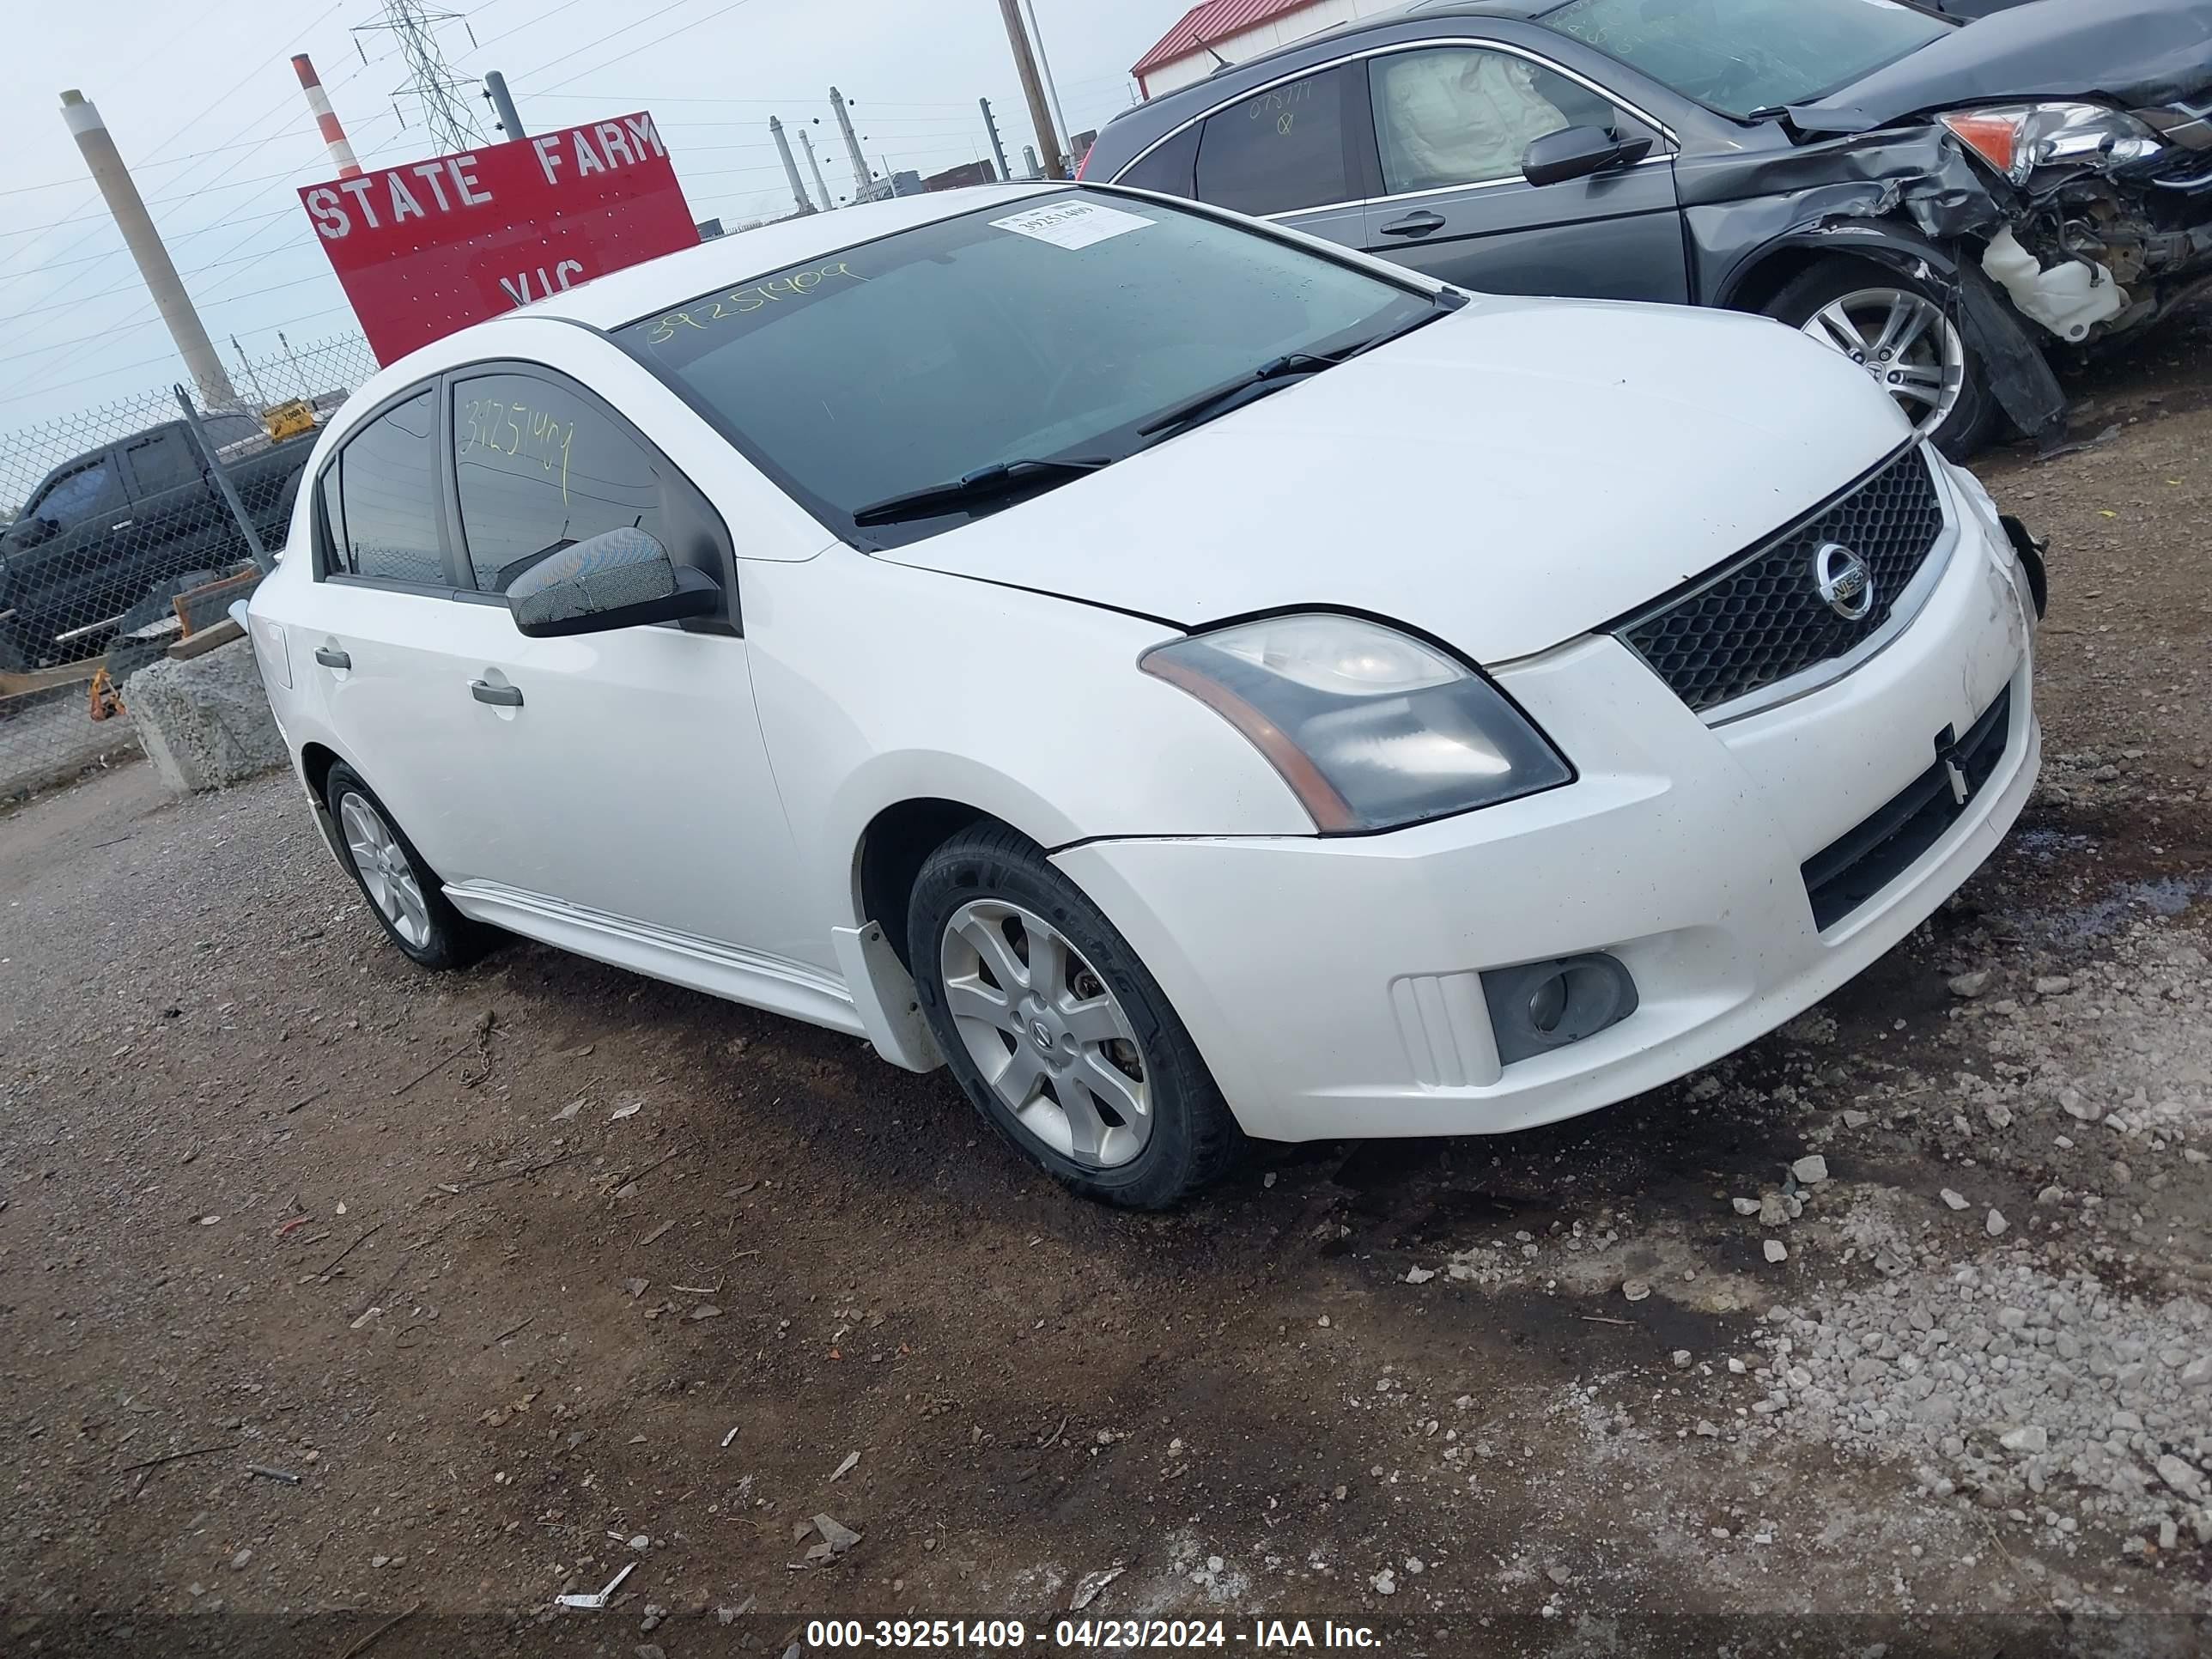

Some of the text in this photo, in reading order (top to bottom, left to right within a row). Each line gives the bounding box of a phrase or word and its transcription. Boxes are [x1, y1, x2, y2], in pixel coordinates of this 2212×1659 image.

[306, 114, 665, 240] STATE FARM
[1018, 205, 1094, 233] 39251409
